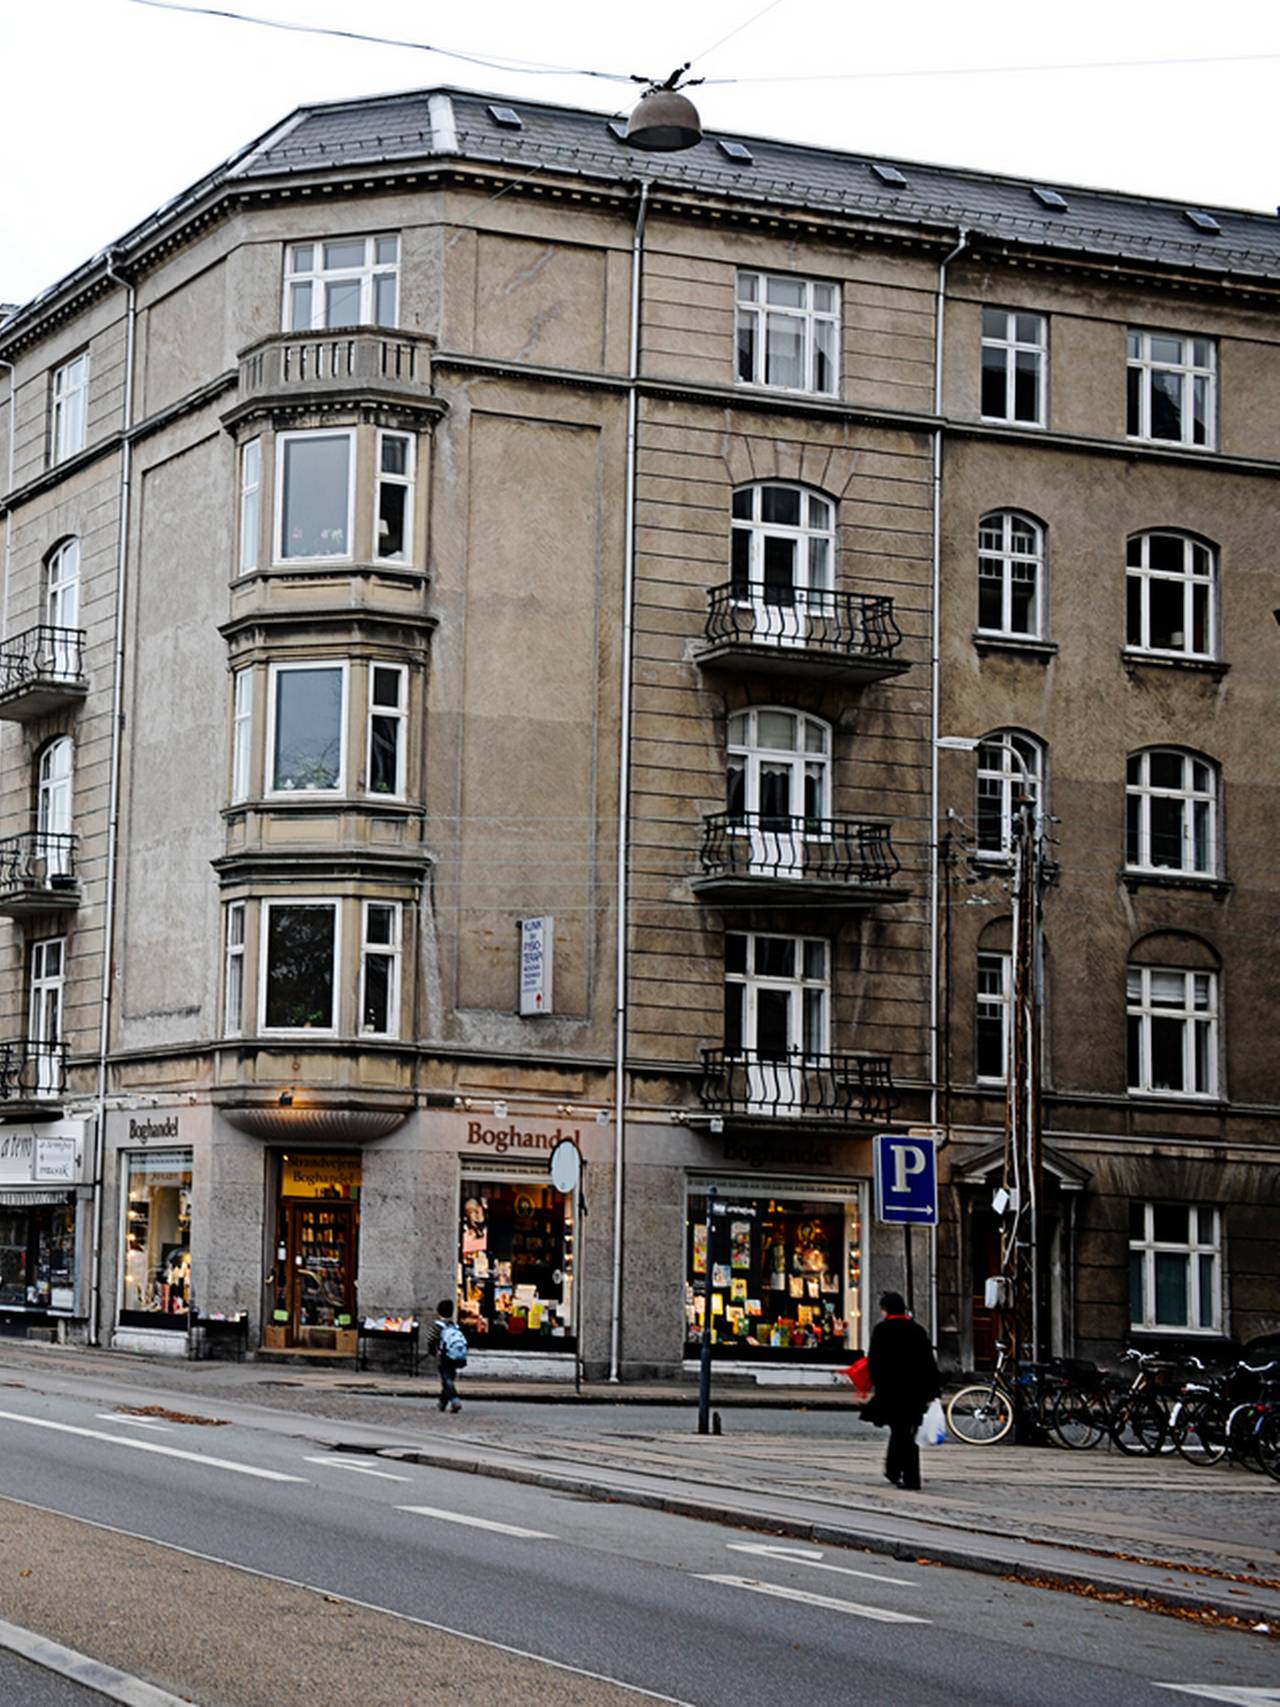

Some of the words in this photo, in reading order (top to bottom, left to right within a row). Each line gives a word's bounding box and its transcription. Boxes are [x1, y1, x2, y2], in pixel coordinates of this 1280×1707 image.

[129, 1116, 178, 1144] Boghandel
[467, 1121, 580, 1153] Boghandl
[723, 1136, 832, 1168] Boghandel
[293, 1169, 353, 1186] Boghandel
[890, 1145, 926, 1193] P
